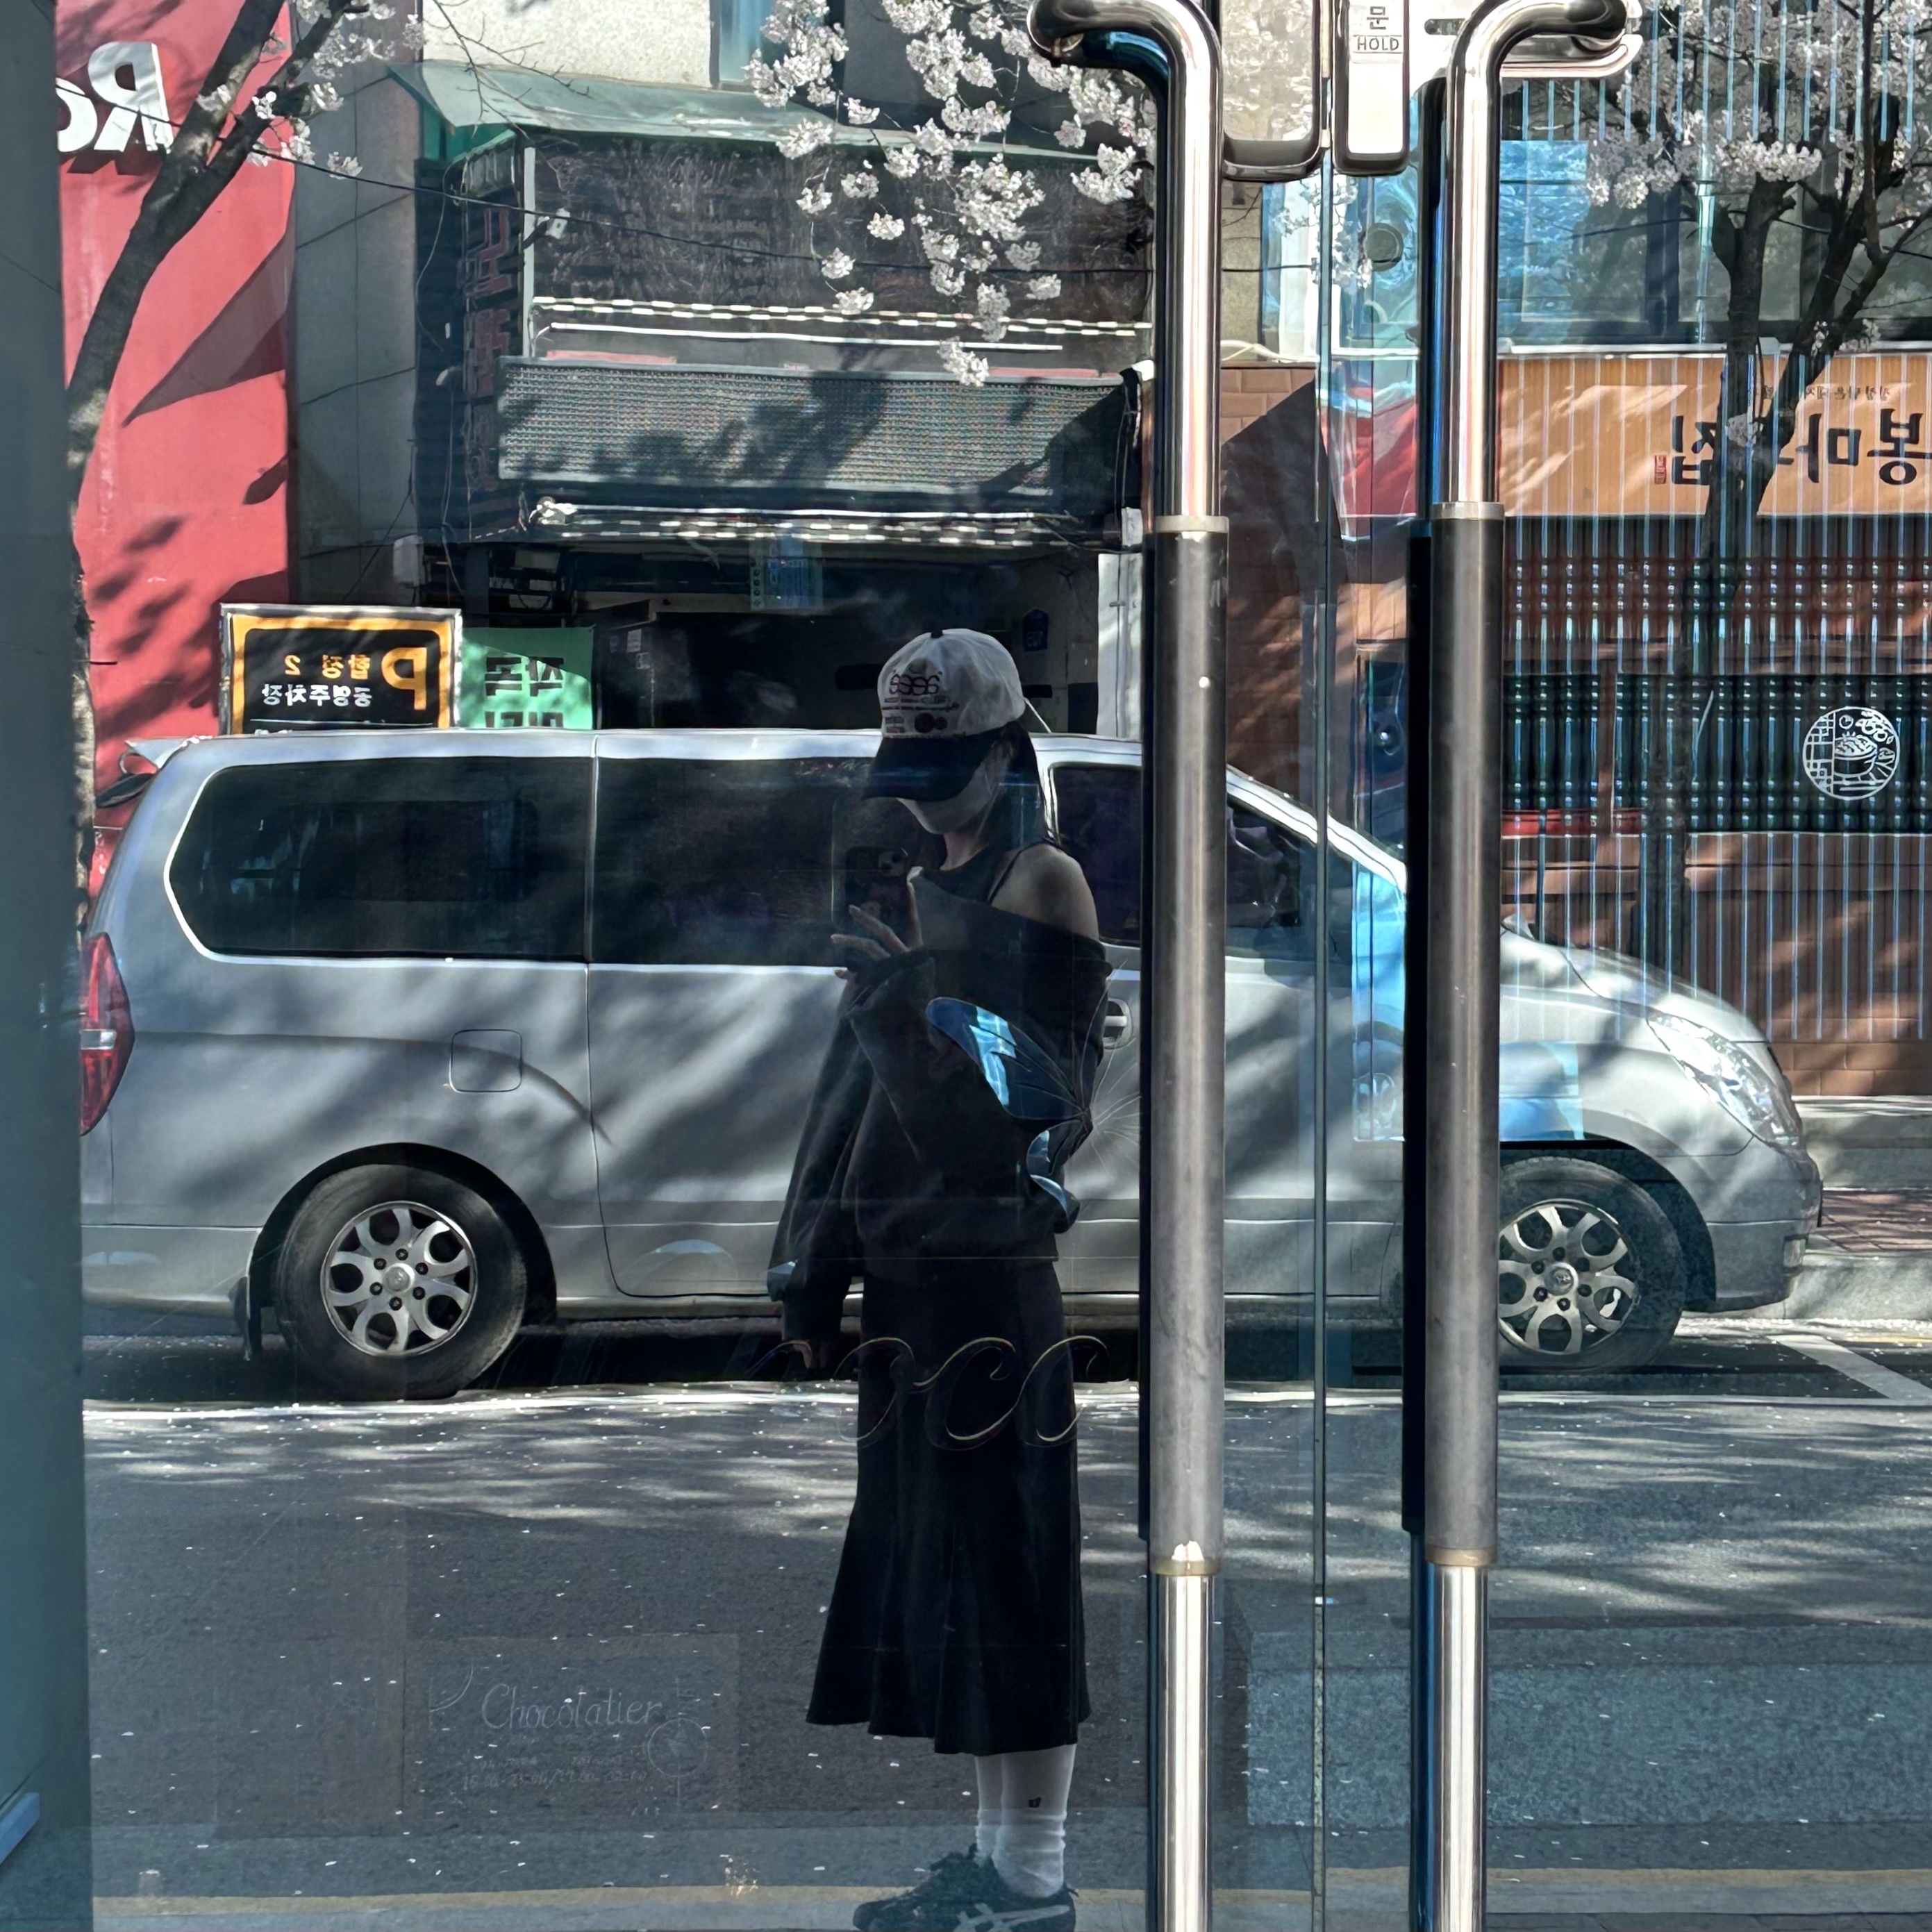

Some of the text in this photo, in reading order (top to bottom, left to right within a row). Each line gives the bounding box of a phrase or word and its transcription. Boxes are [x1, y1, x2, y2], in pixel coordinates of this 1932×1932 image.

[1366, 6, 1389, 30] 문
[1357, 36, 1399, 51] HOLD
[481, 1683, 663, 1730] Chocolatier
